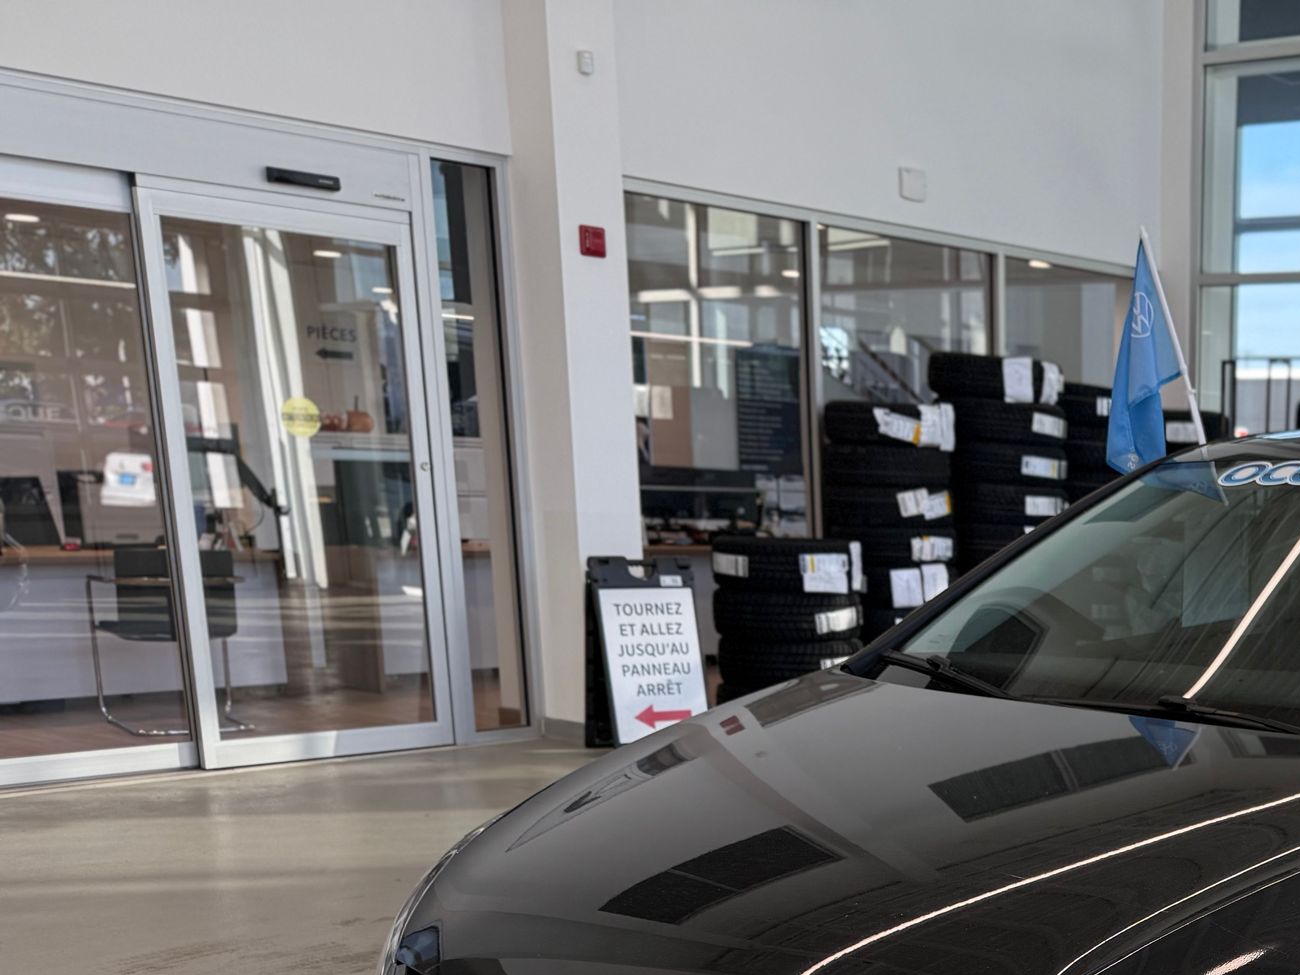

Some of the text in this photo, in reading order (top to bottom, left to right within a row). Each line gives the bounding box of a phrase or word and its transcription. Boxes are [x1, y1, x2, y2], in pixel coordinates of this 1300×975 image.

[306, 322, 358, 343] PIÈCES
[613, 602, 682, 617] TOURNEZ
[619, 622, 684, 637] ET ALLEZ
[618, 642, 690, 658] JUSQU'AU
[622, 662, 691, 677] PANNEAU
[636, 680, 683, 696] ARRÊT
